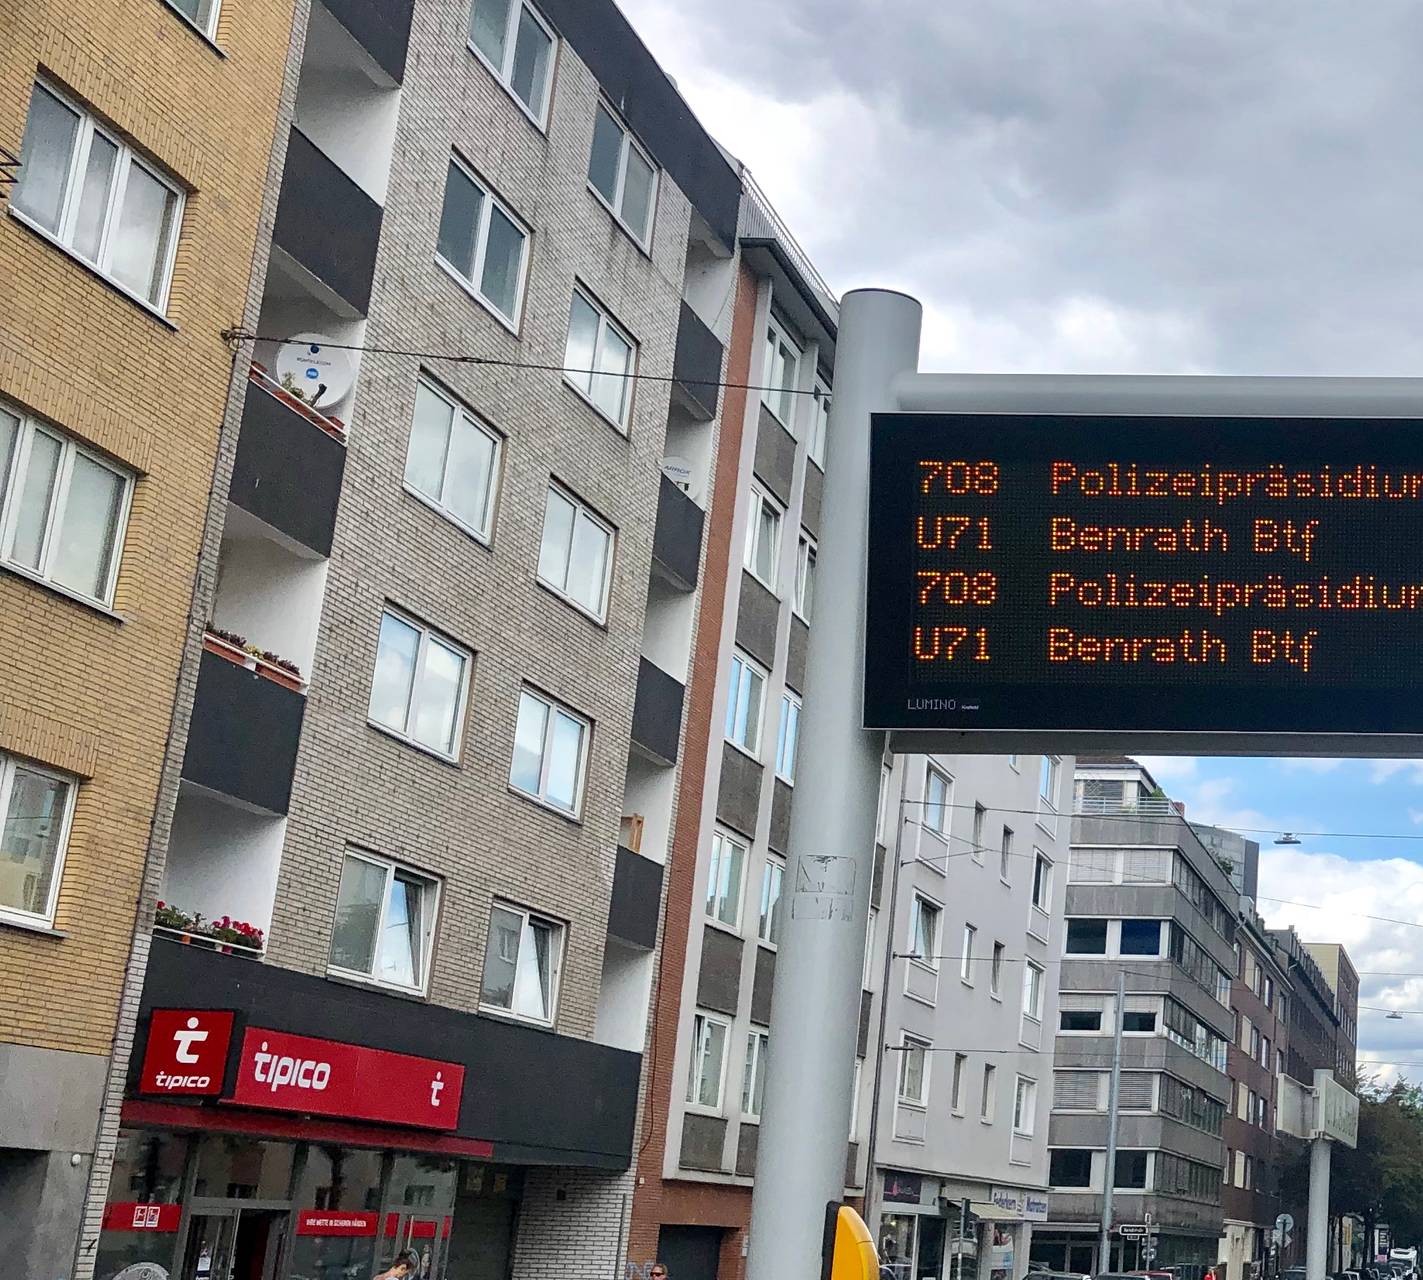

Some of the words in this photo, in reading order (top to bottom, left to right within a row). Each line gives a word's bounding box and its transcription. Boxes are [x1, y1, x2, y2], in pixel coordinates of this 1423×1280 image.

[919, 461, 998, 494] 708
[916, 516, 992, 549] U71
[1051, 517, 1229, 551] Benrath
[1253, 520, 1320, 561] Btf
[917, 571, 997, 604] 708
[914, 627, 991, 660] U71
[1049, 628, 1226, 662] Benrath
[1252, 630, 1319, 672] Btf
[907, 698, 957, 710] LUMINO
[155, 1071, 210, 1090] tipico
[254, 1041, 332, 1092] tipico
